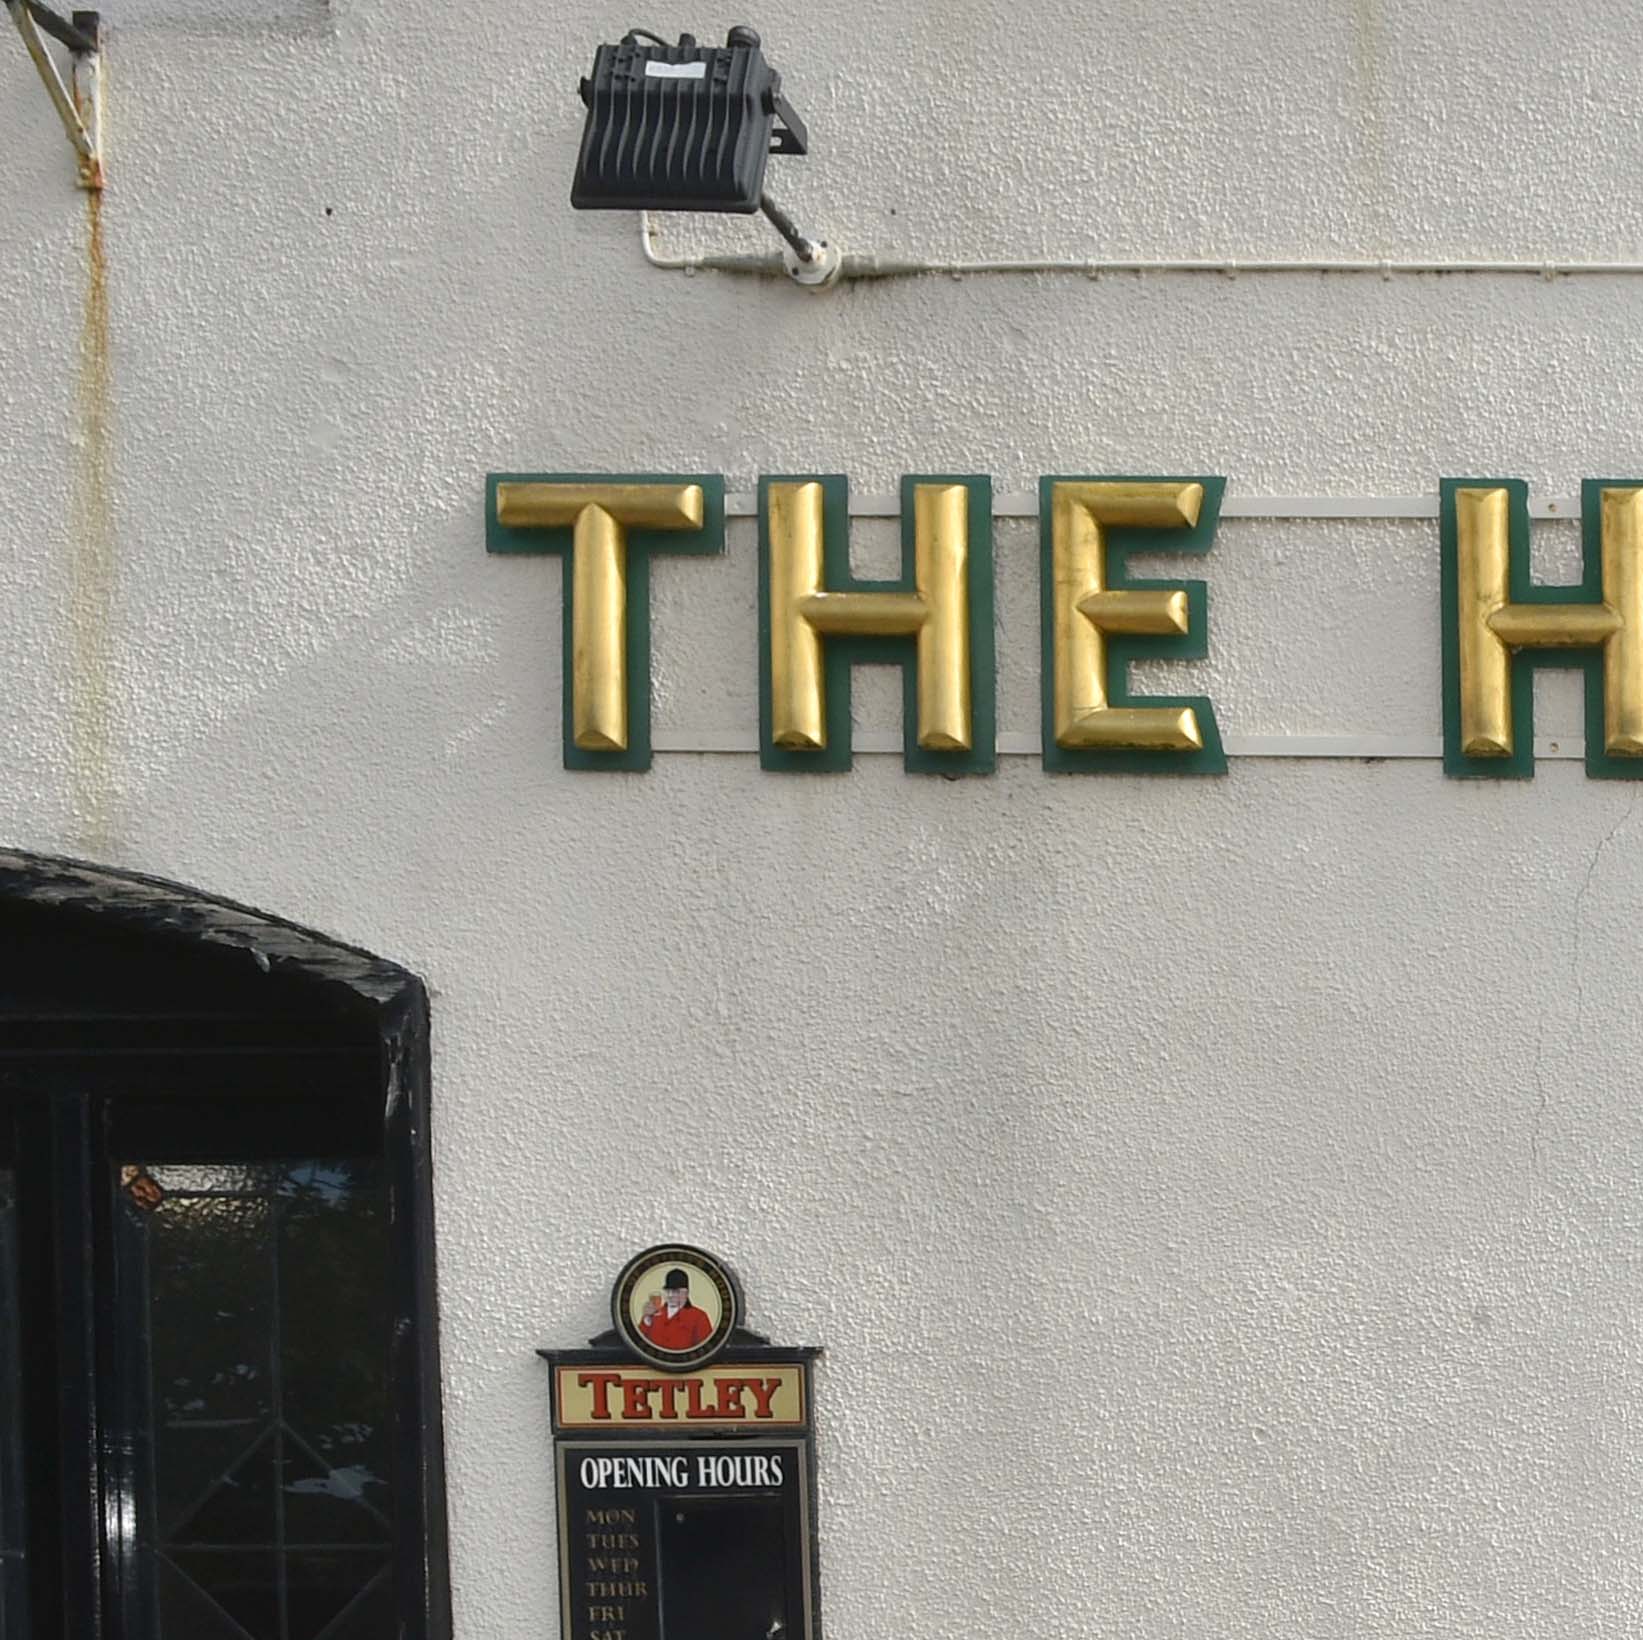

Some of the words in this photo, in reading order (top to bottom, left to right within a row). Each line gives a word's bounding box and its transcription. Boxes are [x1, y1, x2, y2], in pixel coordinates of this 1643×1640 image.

[486, 472, 1228, 775] THE
[578, 1373, 782, 1420] TETLEY
[580, 1457, 689, 1488] OPENING
[698, 1455, 784, 1487] HOURS
[585, 1509, 635, 1525] MON
[585, 1534, 640, 1549] TUES
[586, 1557, 640, 1573] WED
[585, 1582, 648, 1598] THUR
[588, 1606, 625, 1622] FRI
